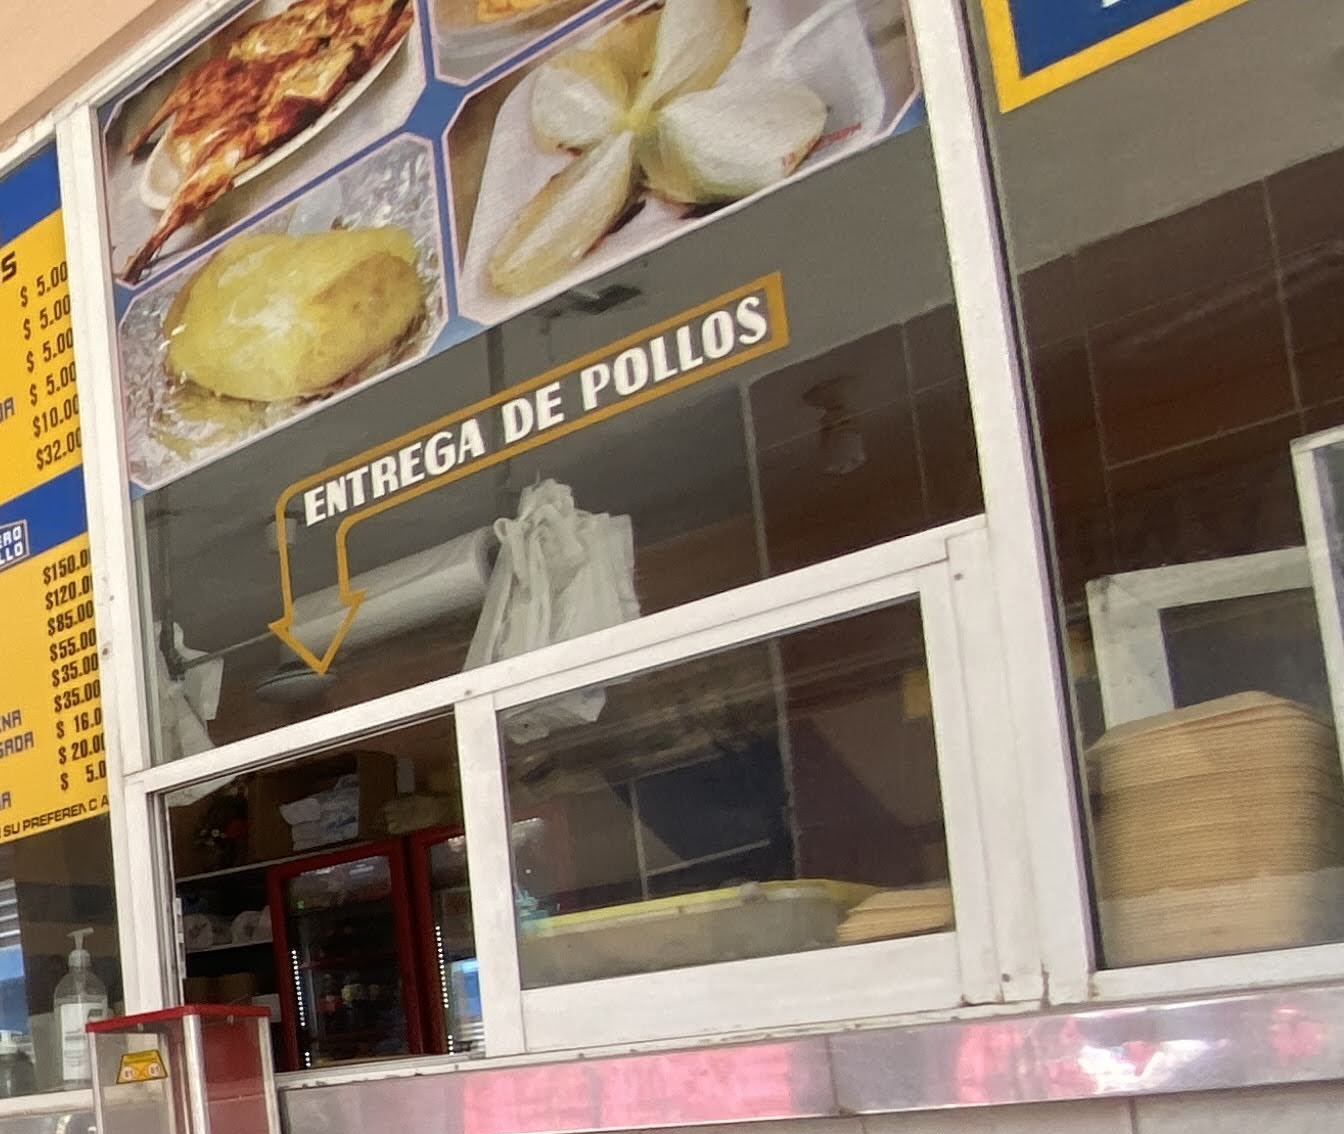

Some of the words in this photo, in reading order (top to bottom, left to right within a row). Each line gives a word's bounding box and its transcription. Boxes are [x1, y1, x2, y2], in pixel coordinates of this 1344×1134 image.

[36, 261, 68, 297] 5.00
[39, 294, 71, 330] 5.00
[43, 327, 74, 363] 5.00
[46, 361, 77, 396] 5.00
[32, 394, 80, 438] $10.00
[302, 417, 486, 527] ENTREGA
[500, 381, 566, 444] DE
[579, 296, 769, 412] POLLOS
[36, 427, 82, 471] $32.00
[43, 548, 90, 586] $150.0
[47, 600, 95, 638] $85.00
[49, 627, 97, 663] $55.00
[51, 652, 99, 688] $35.00
[54, 679, 101, 713] $35.00
[3, 821, 21, 838] SU
